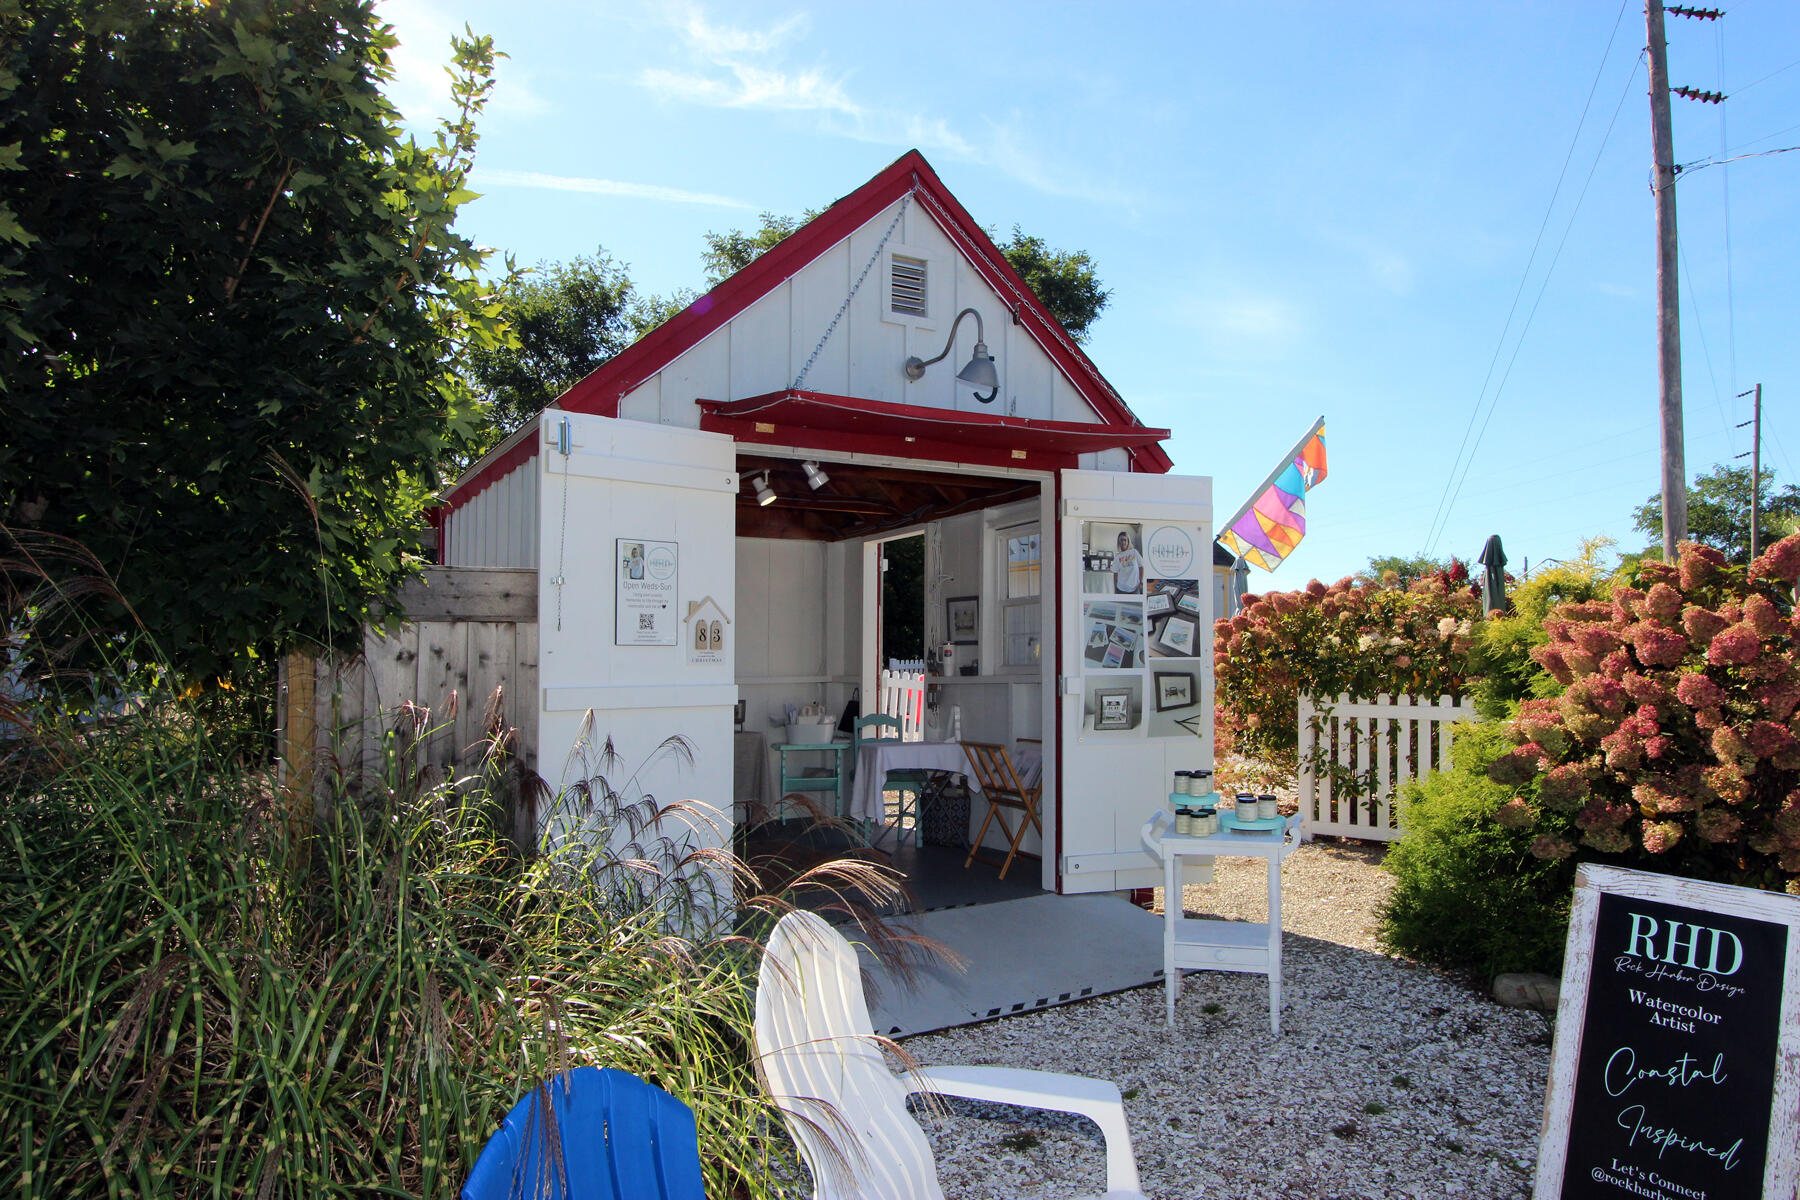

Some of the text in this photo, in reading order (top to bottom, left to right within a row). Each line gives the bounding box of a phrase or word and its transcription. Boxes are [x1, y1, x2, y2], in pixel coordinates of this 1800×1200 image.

[623, 581, 672, 591] Open Weds-Sun
[1623, 912, 1743, 976] RHD
[1614, 956, 1746, 997] Rock Harbor Design
[1628, 988, 1722, 1024] Watercolor
[1649, 1012, 1696, 1033] Artist
[1605, 1047, 1727, 1097] Coastal
[1617, 1104, 1744, 1170] Inspired
[1611, 1158, 1707, 1200] Let's Connect
